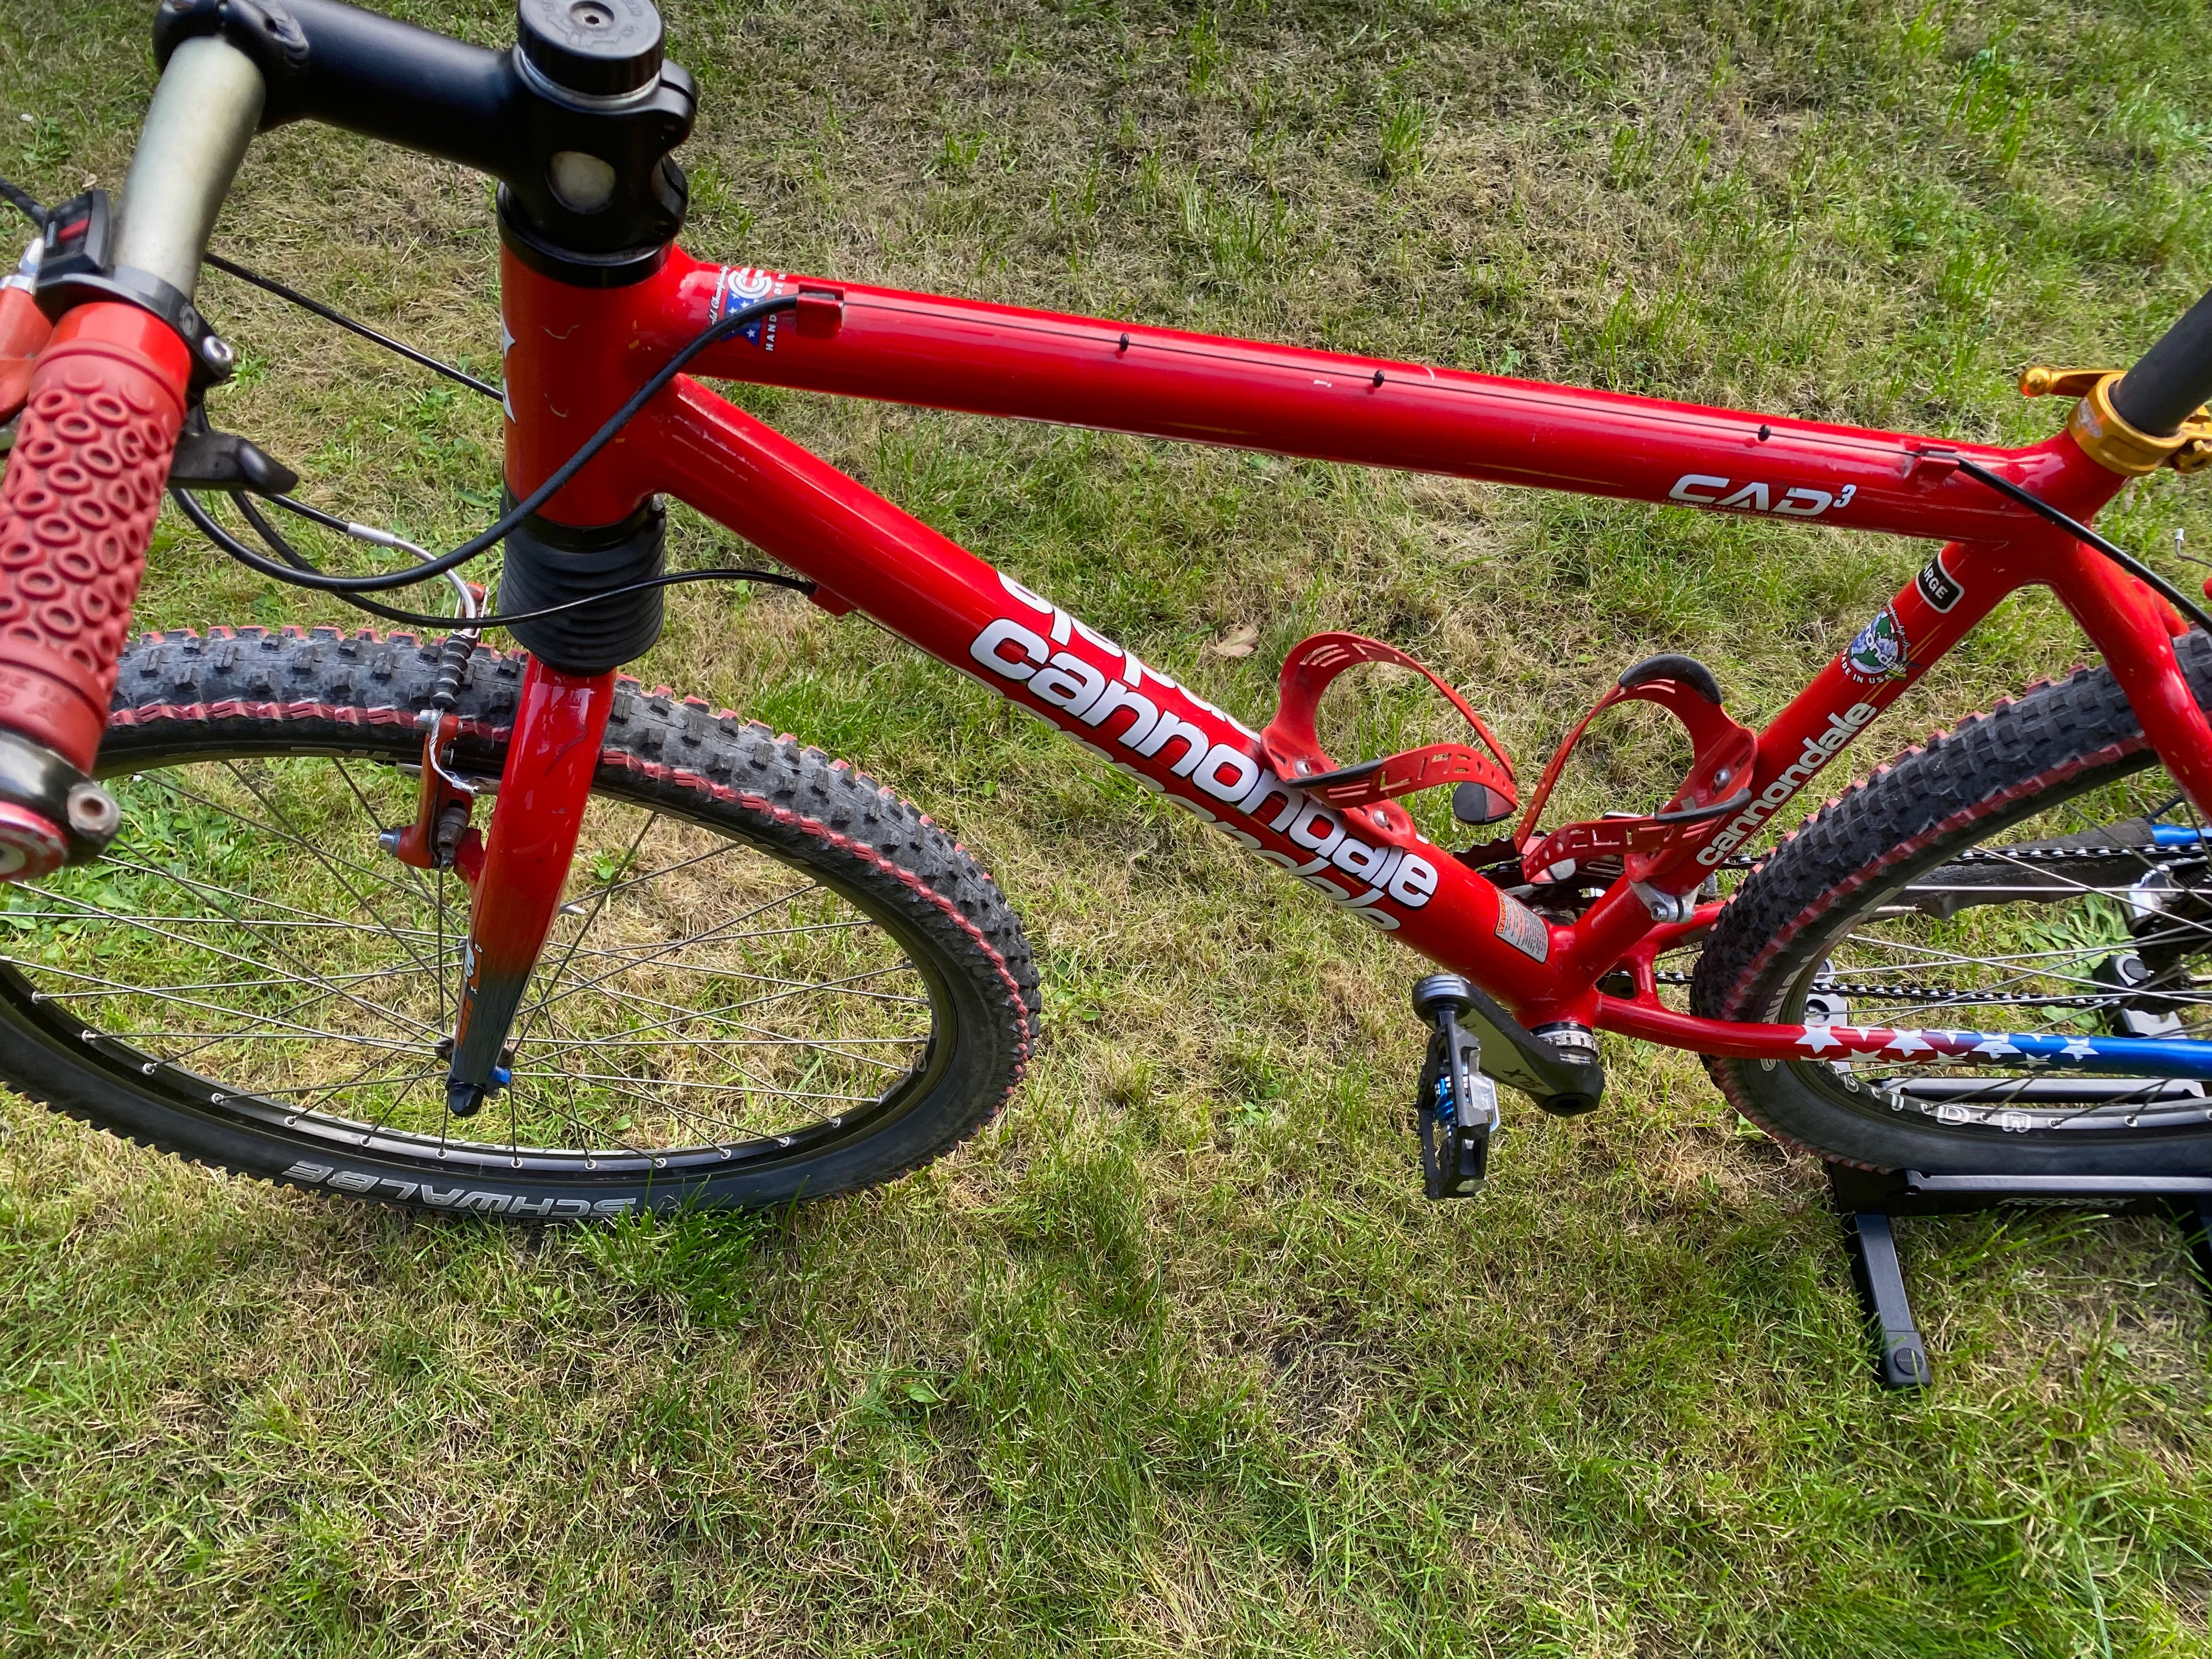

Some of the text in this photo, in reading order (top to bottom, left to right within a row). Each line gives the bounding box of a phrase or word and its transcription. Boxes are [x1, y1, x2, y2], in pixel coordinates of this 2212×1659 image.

[1923, 562, 1949, 600] ARGE
[1853, 673, 1864, 684] IN
[1869, 674, 1891, 684] USA
[1696, 702, 1878, 866] cannondale
[281, 1160, 636, 1220] SCHWALBE
